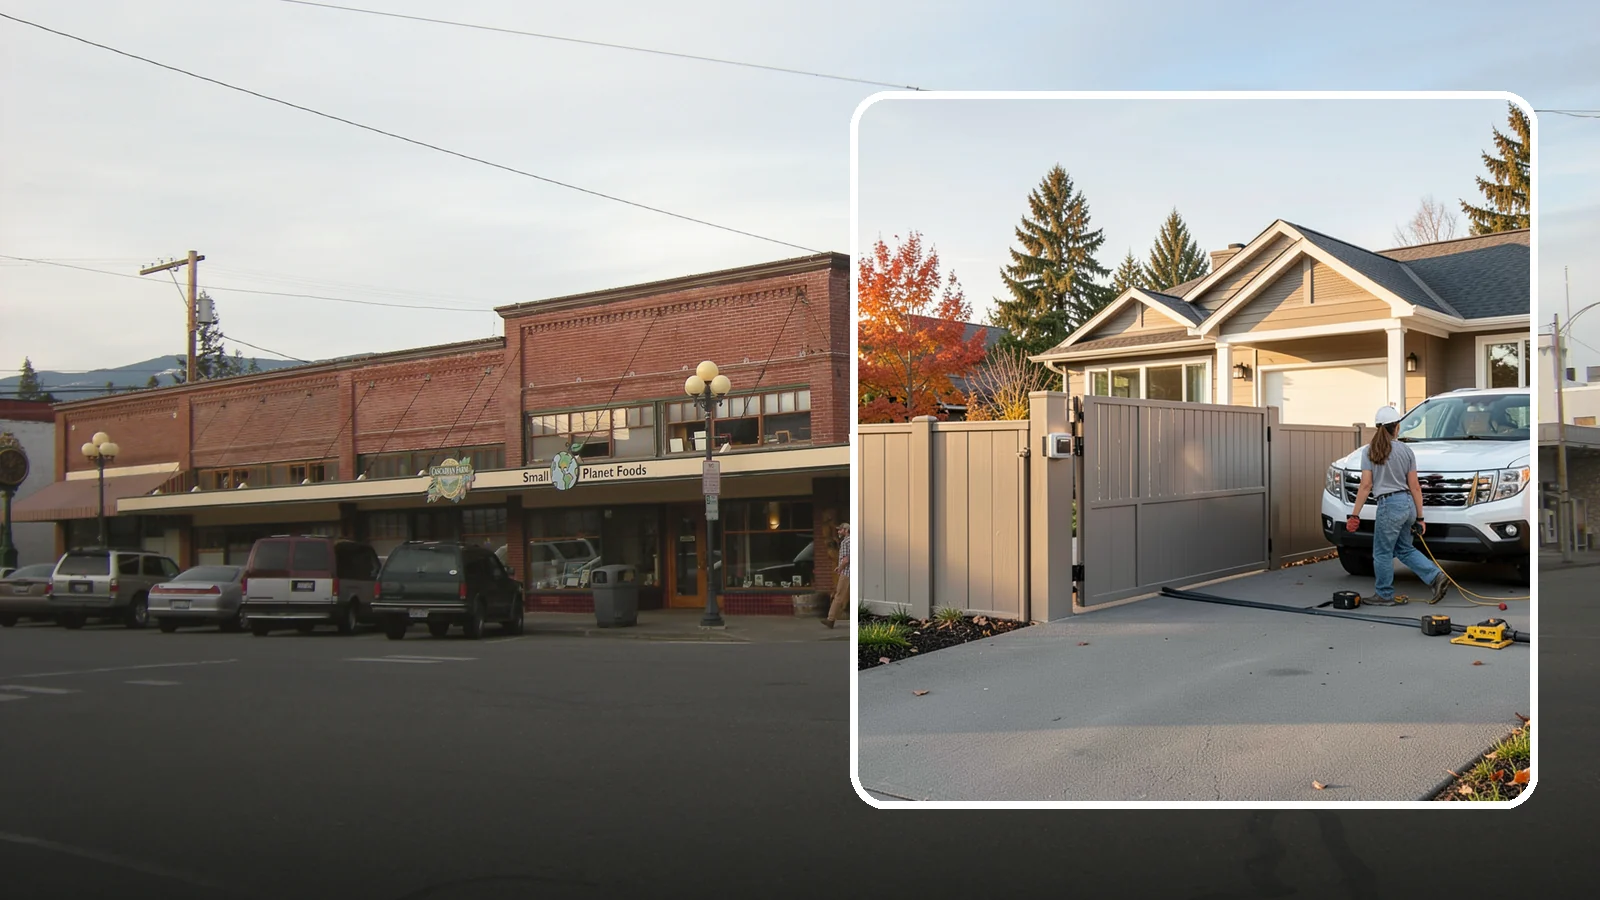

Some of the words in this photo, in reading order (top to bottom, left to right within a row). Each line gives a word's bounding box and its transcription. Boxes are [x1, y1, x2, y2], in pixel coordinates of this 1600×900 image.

[523, 470, 549, 483] Small
[583, 467, 614, 479] Planet
[617, 464, 647, 477] Foods
